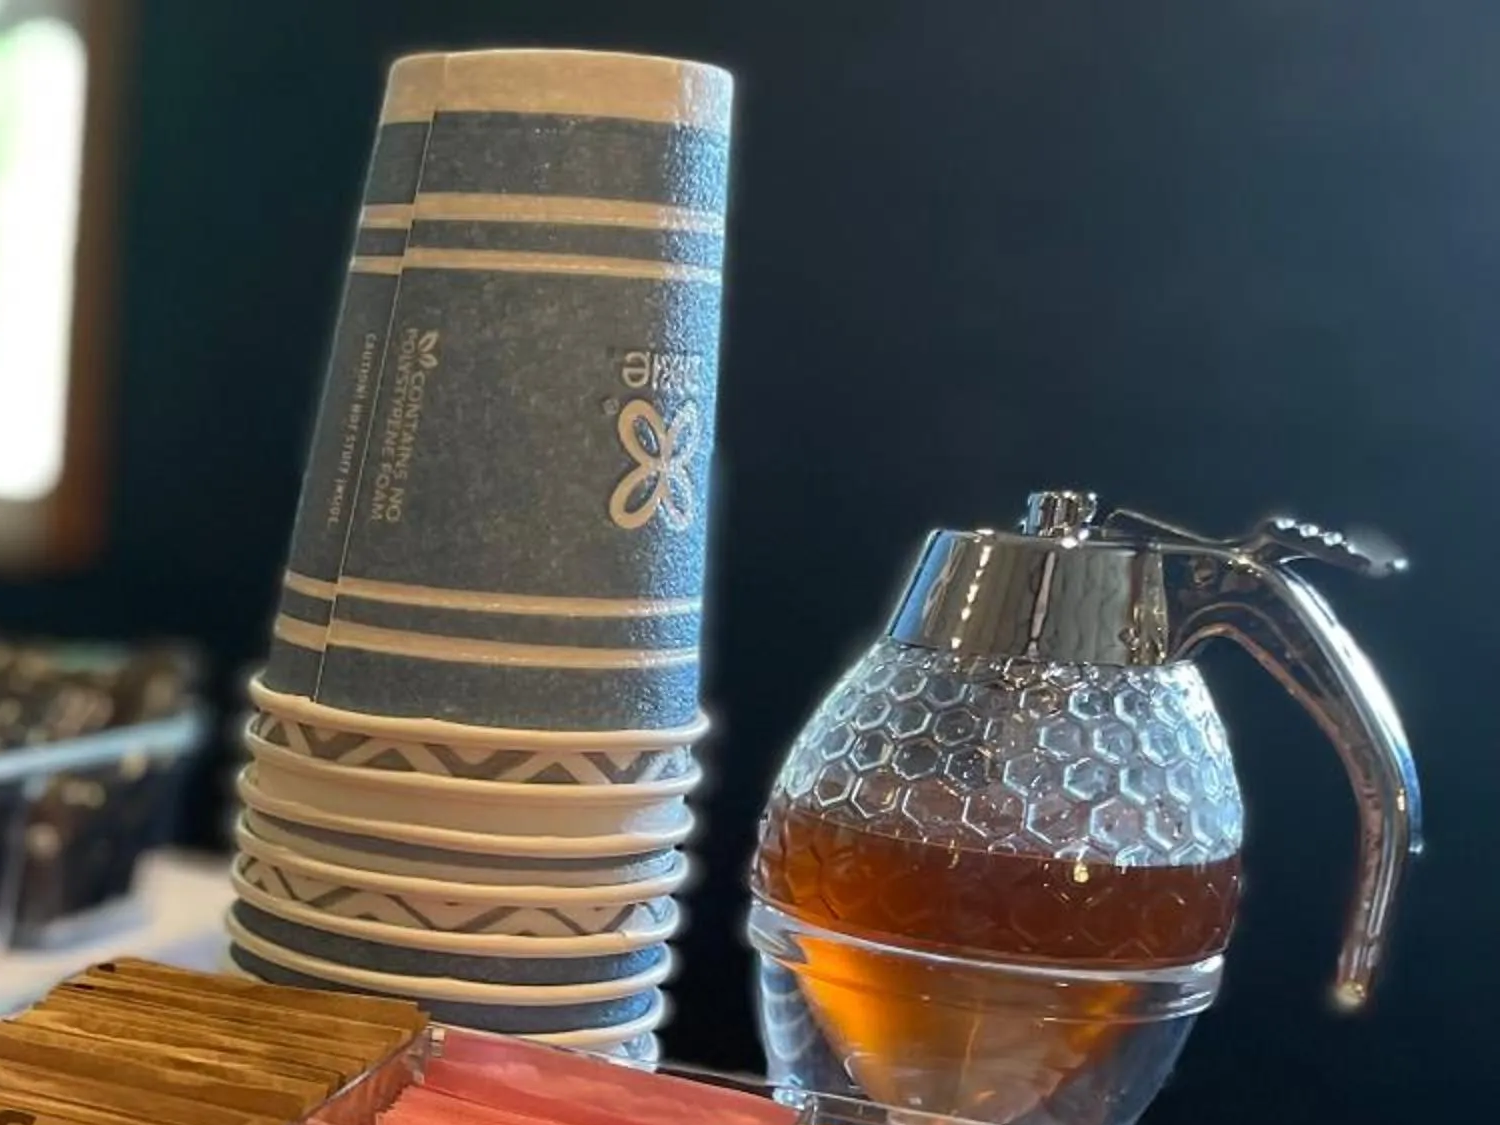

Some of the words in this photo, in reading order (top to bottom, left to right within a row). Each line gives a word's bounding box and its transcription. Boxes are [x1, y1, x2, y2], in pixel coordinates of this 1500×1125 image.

[381, 327, 419, 459] POLYSTYRENE
[393, 370, 426, 481] CONTAINS
[369, 462, 394, 521] FOAM
[384, 486, 406, 524] NO
